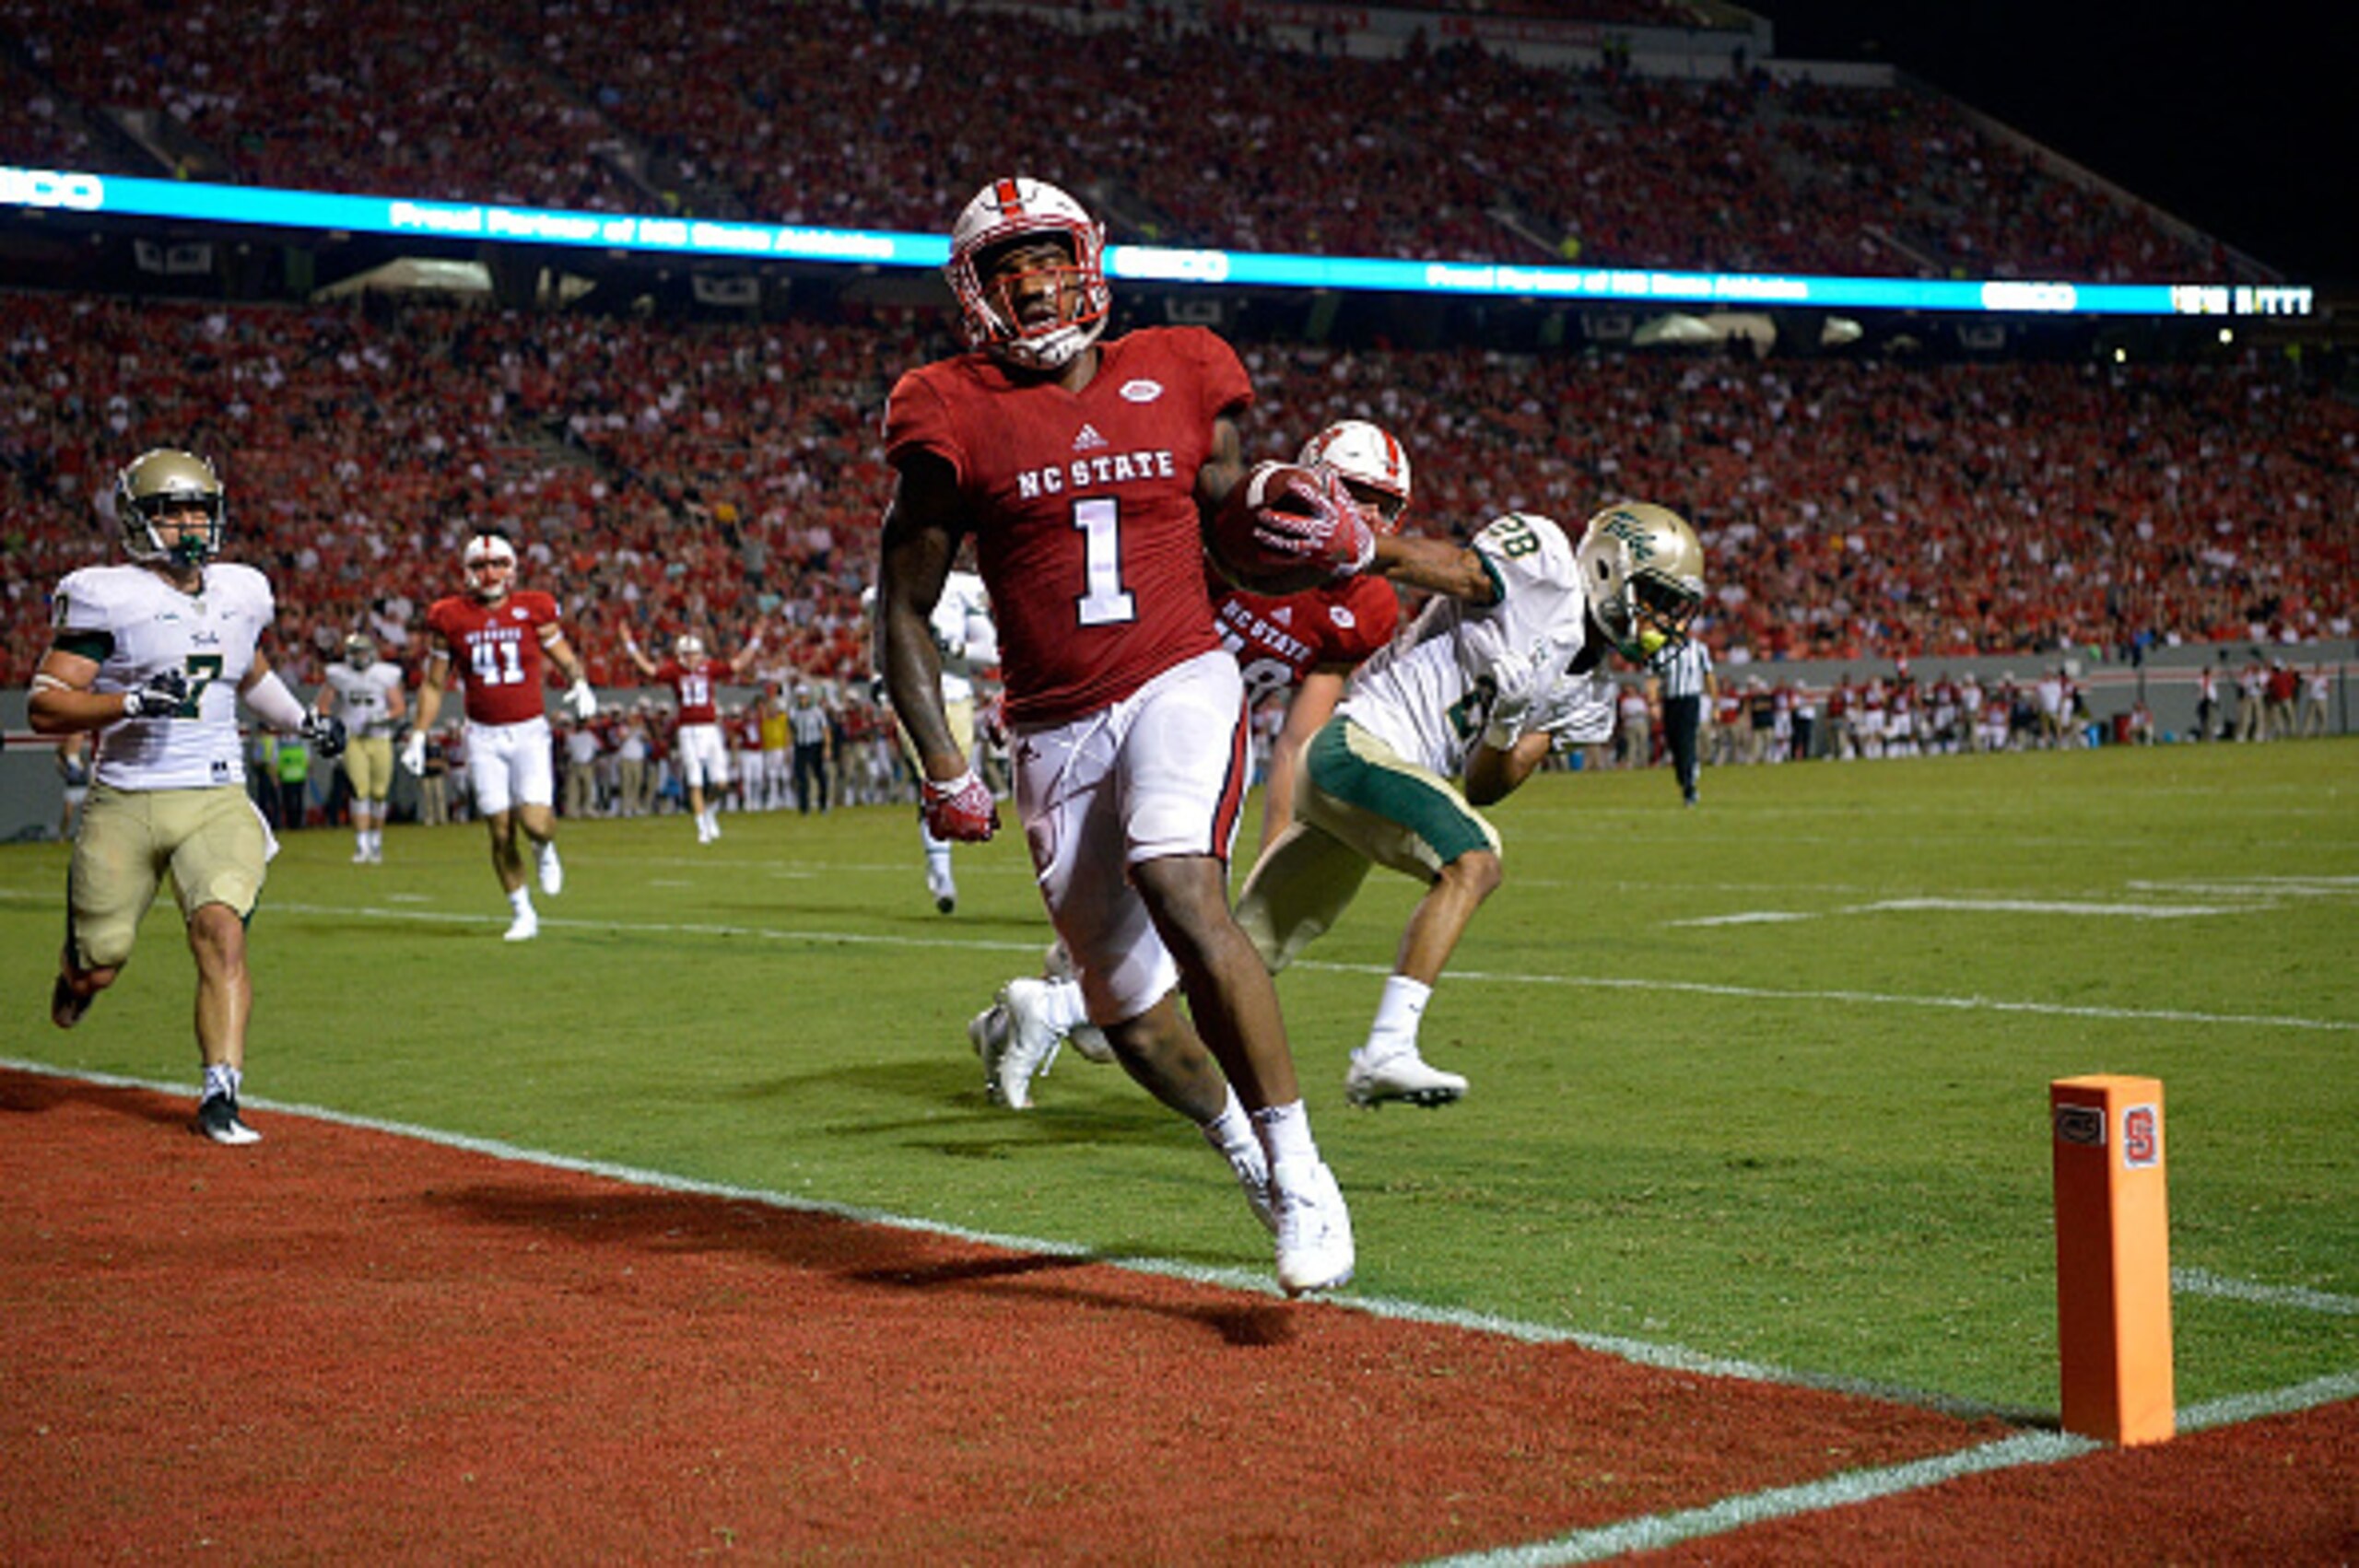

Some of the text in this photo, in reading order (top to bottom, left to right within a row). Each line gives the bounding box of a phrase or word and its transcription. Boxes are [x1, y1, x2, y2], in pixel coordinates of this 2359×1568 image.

[1017, 451, 1175, 498] NC STATE
[1074, 497, 1136, 626] 1
[1488, 514, 1541, 558] 28
[1221, 599, 1311, 663] NC STATE
[181, 654, 223, 720] 7
[472, 642, 524, 685] 41
